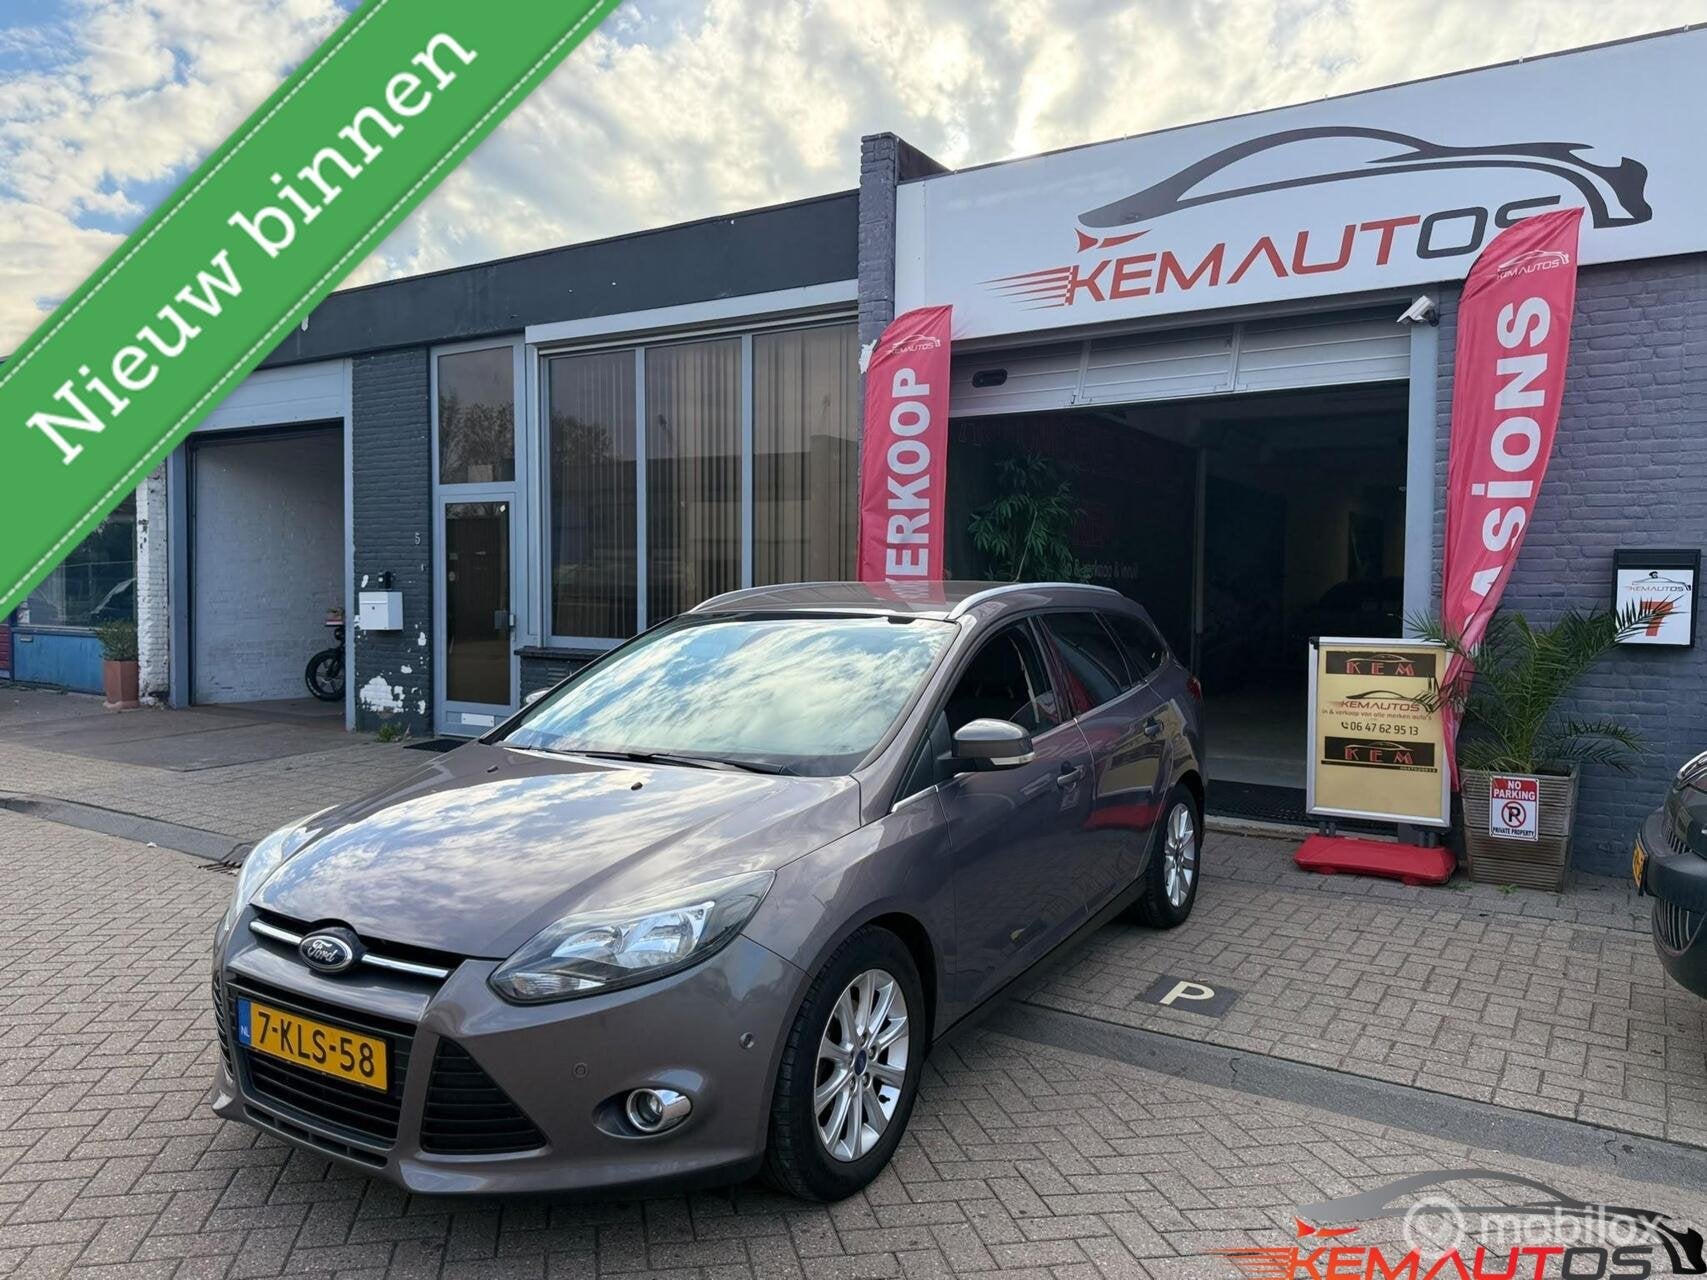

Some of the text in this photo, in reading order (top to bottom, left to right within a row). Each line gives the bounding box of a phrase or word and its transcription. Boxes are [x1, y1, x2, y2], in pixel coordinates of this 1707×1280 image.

[884, 367, 931, 584] ERKOOP
[1640, 601, 1674, 637] 7
[1346, 661, 1415, 676] KEM
[1340, 701, 1420, 712] KEMAUTOS
[1350, 721, 1419, 736] 06 47 62 95 13
[1344, 748, 1414, 765] KEM
[1507, 780, 1522, 790] NO
[1493, 788, 1536, 801] PARKING
[307, 939, 338, 962] Ford
[1159, 980, 1216, 1006] P
[257, 1012, 375, 1078] 7-KLS-58
